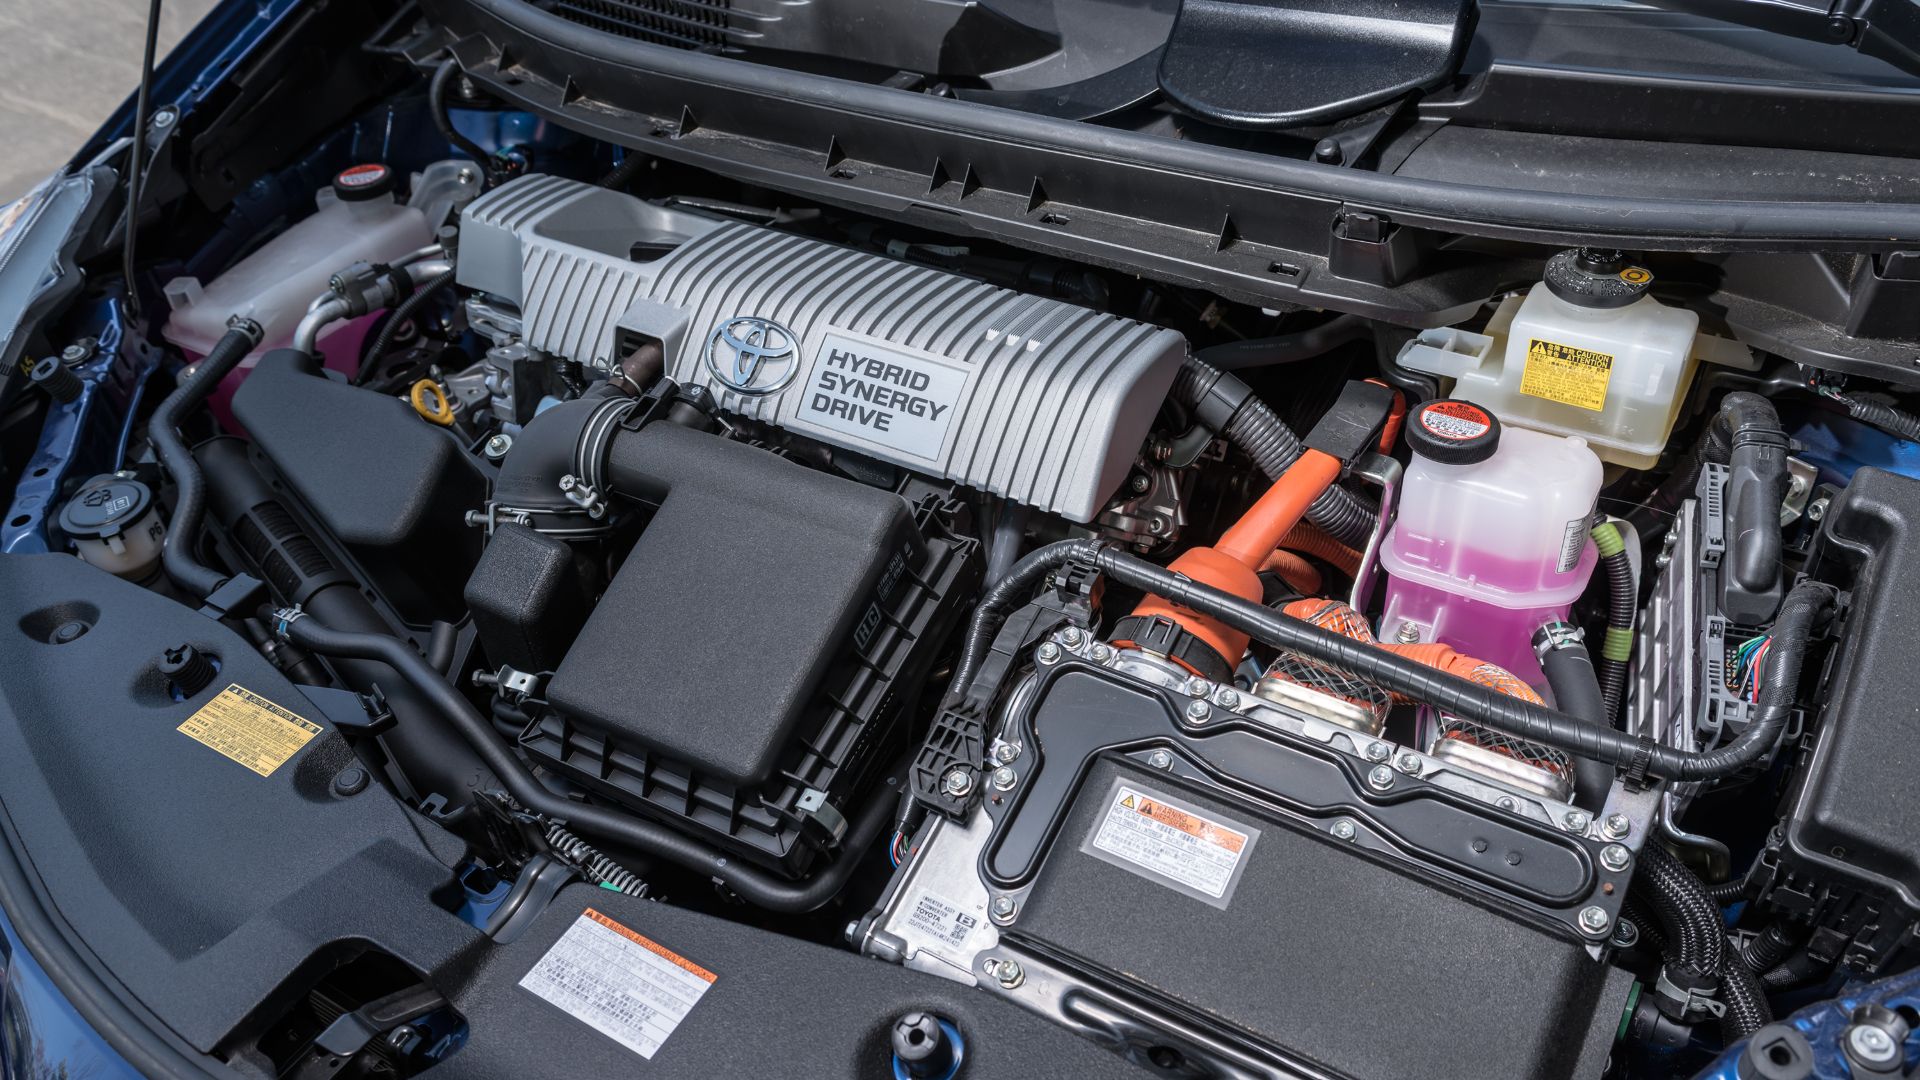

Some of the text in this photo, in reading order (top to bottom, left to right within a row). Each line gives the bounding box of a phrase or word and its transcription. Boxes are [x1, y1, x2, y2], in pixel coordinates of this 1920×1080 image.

[1566, 354, 1607, 368] ATTENTION
[1576, 350, 1609, 362] CAUTION
[827, 348, 931, 392] HYBRID
[818, 370, 949, 421] SYNERGY
[811, 393, 893, 432] DRIVE
[148, 521, 164, 541] P6
[248, 696, 294, 720] CAUTION ATTENTION
[1152, 810, 1193, 832] AVERTISSEMENT
[1155, 804, 1188, 822] WARNING
[921, 895, 943, 908] INVERTER
[915, 906, 941, 921] TOYOTA
[607, 920, 636, 939] WARNING
[632, 934, 681, 963] AVERTISSEMENT
